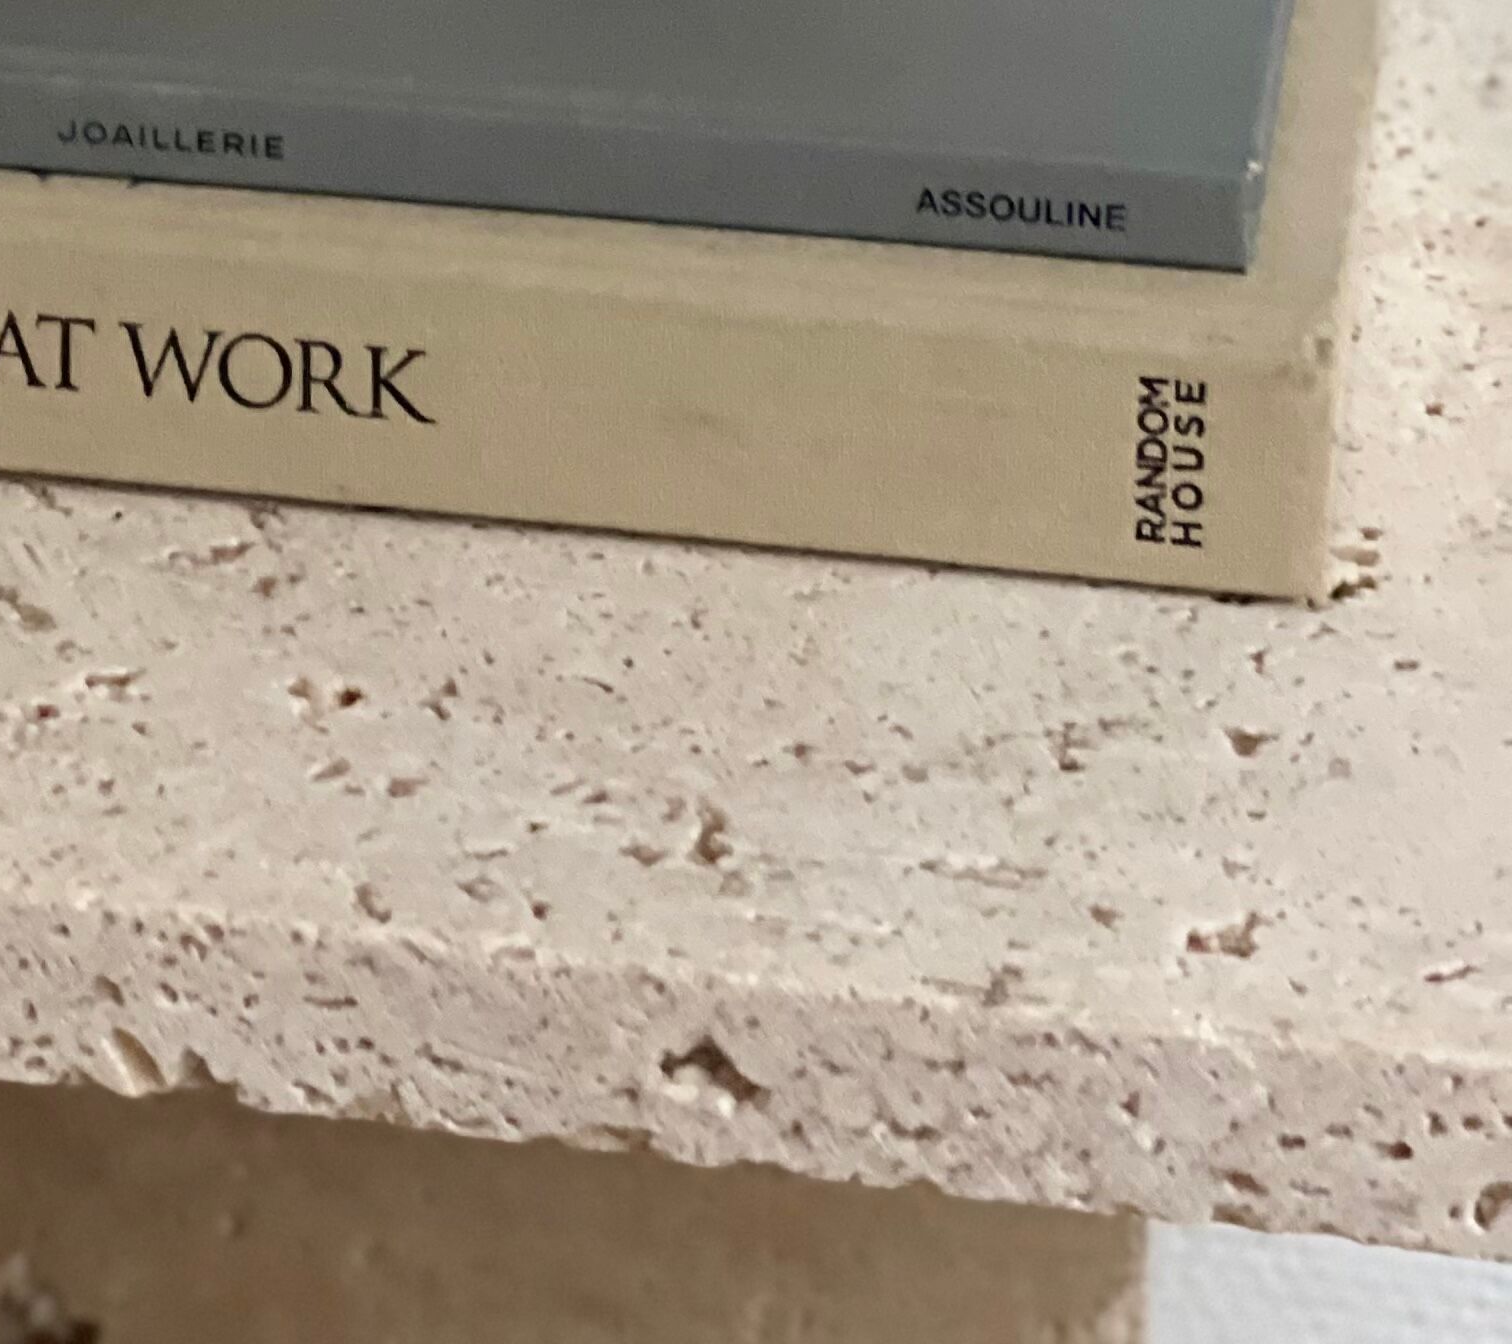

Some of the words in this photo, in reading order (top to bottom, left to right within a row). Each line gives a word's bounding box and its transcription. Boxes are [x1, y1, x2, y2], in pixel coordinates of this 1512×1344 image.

[57, 119, 285, 161] JOAILLERIE
[915, 186, 1128, 232] ASSOULINE
[118, 320, 439, 426] WORK
[1134, 374, 1169, 544] RANDOM
[1171, 378, 1208, 549] HOUSE
